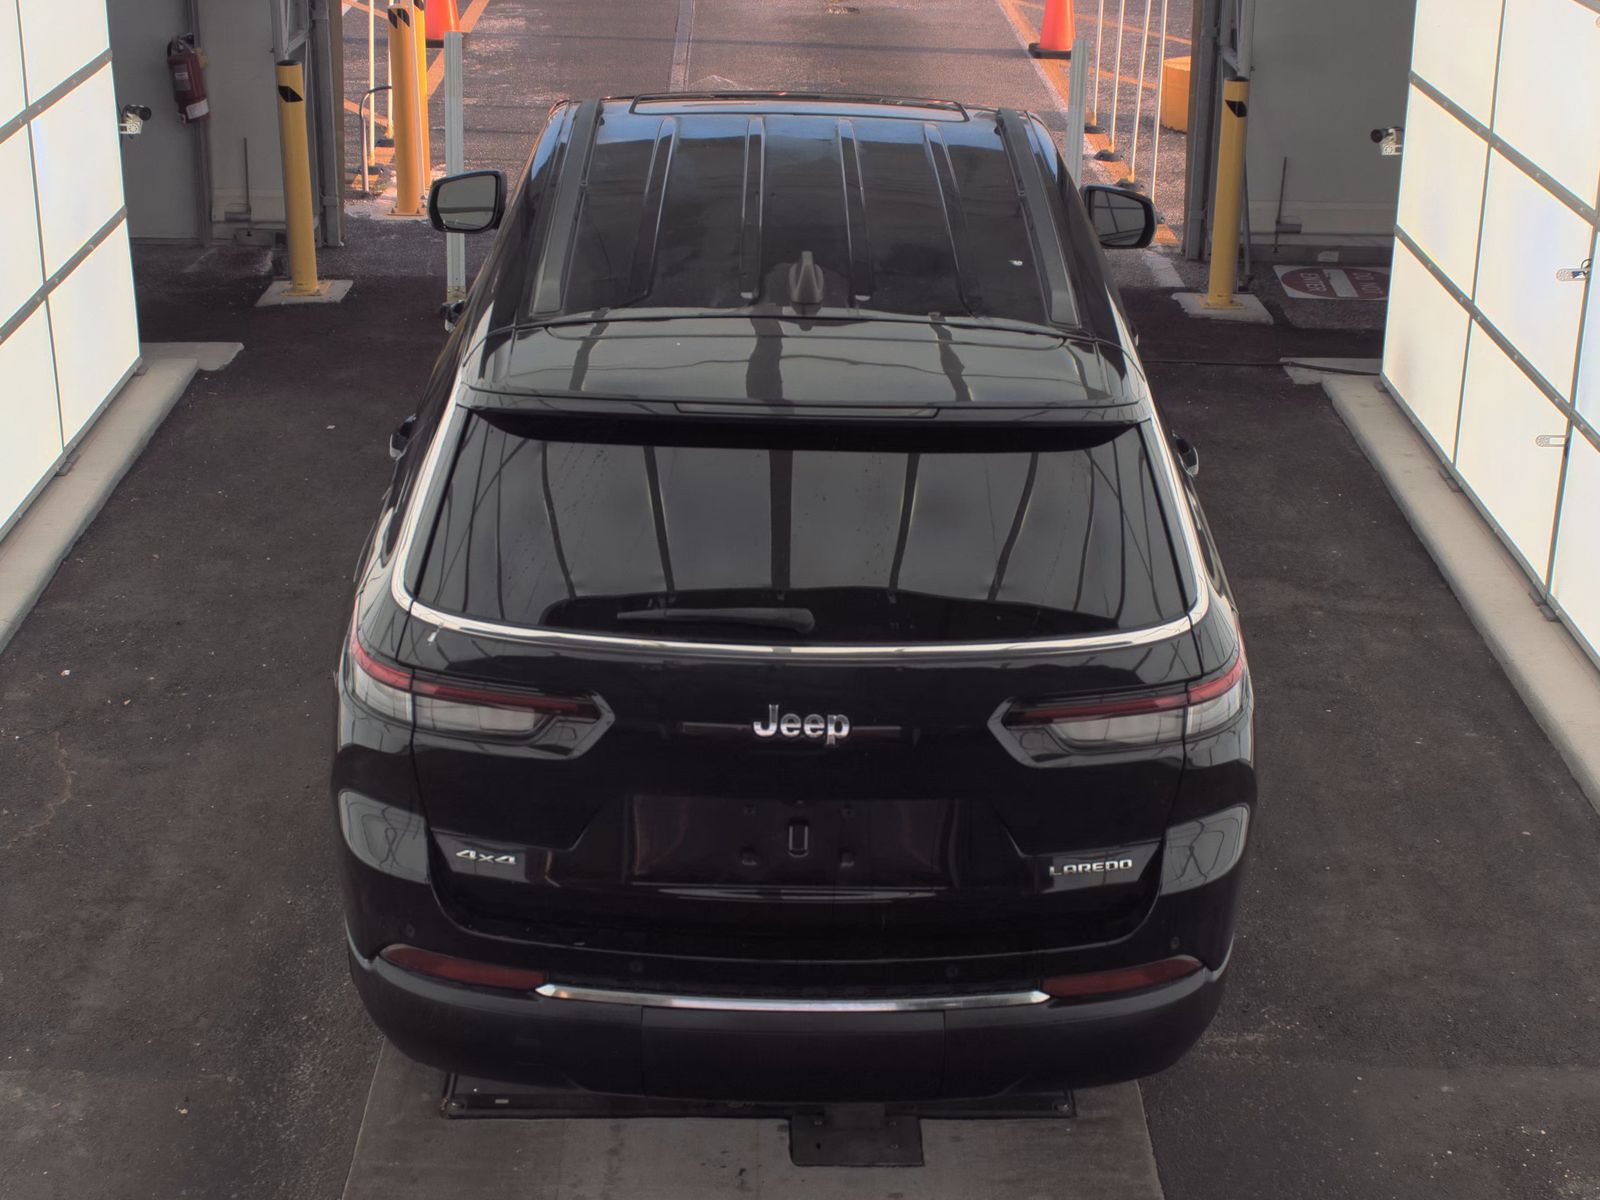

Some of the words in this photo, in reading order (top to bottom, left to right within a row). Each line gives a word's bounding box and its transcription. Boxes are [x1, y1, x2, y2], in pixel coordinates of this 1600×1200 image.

[1300, 272, 1327, 292] ENTER
[1352, 272, 1375, 281] DO
[1360, 282, 1383, 294] NOT
[753, 703, 850, 745] Jeep
[455, 849, 517, 865] 4x4
[1049, 859, 1133, 876] LAREDO
